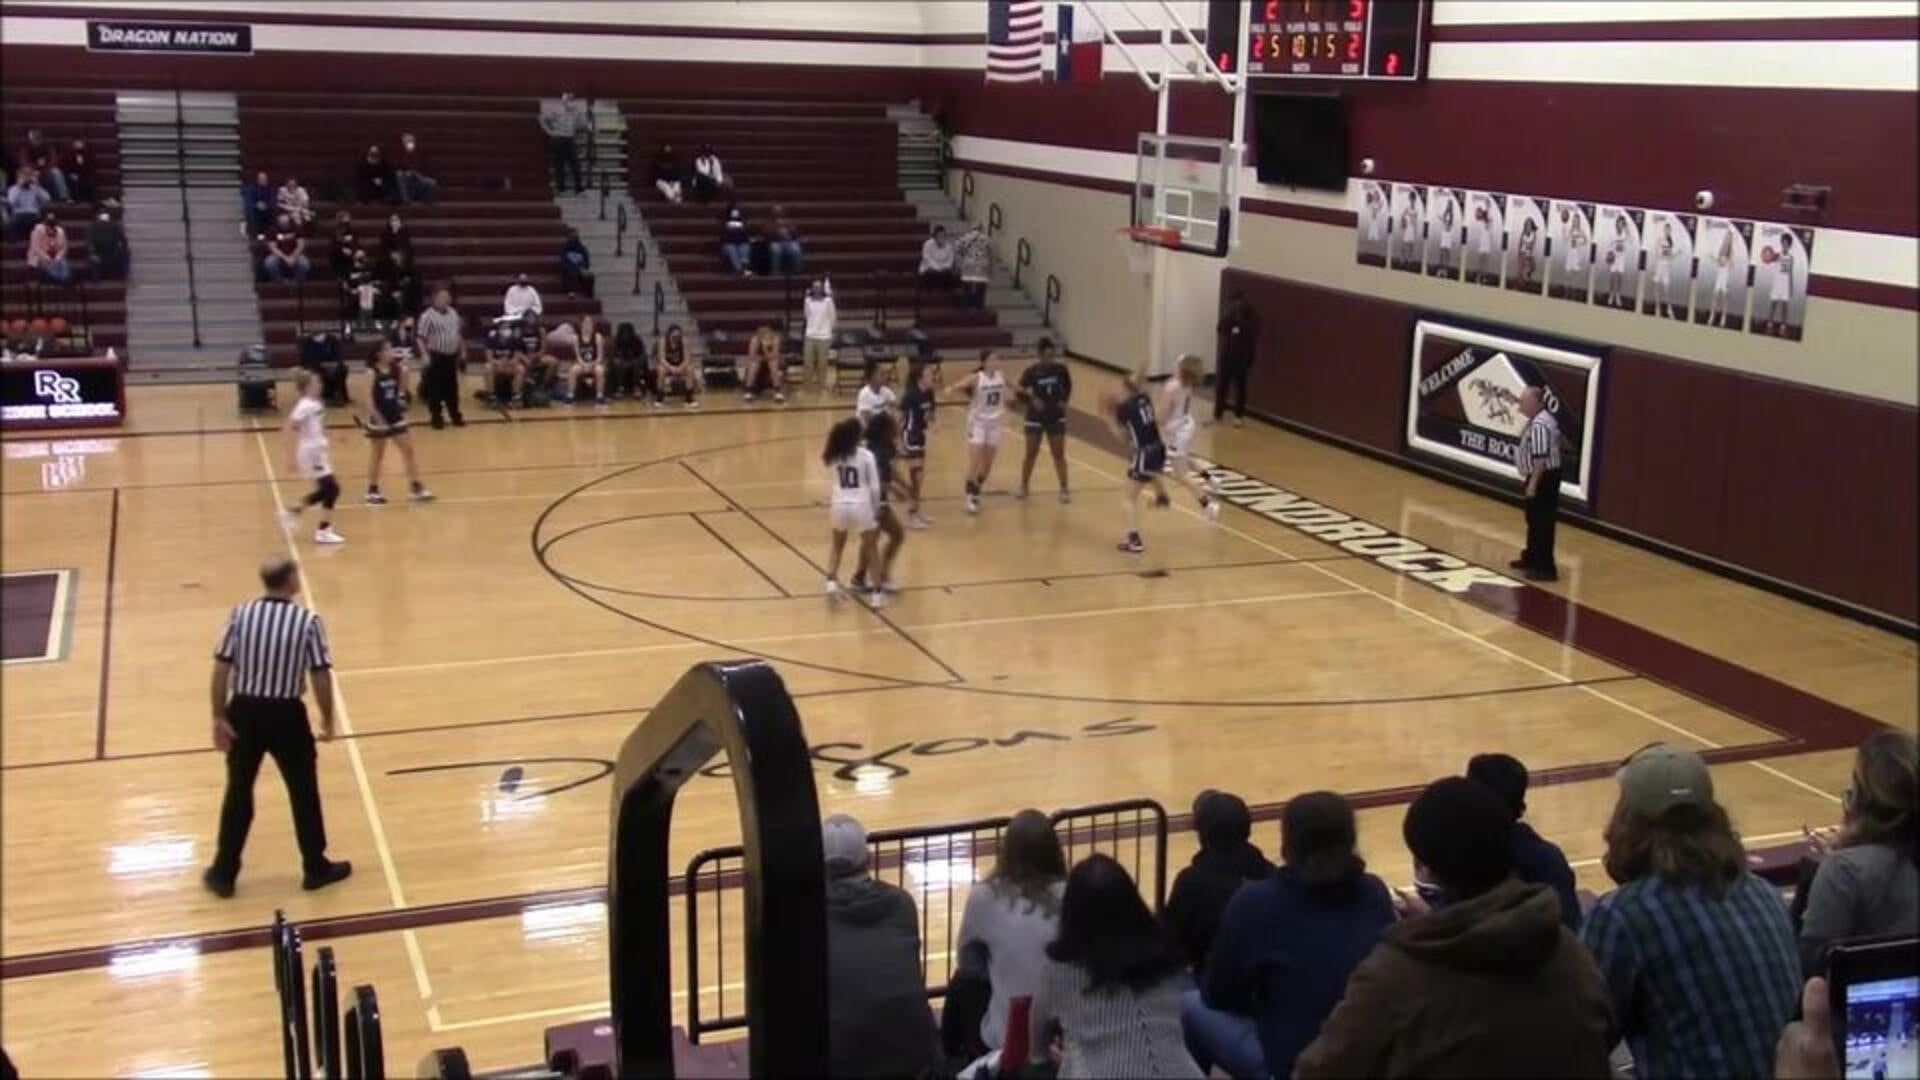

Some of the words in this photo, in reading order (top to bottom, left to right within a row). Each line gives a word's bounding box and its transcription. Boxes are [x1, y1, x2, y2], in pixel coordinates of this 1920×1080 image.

[173, 31, 238, 46] NATION
[1270, 34, 1281, 58] 5
[1326, 33, 1336, 58] 5
[1418, 348, 1476, 397] WELCOME
[1541, 384, 1560, 414] TO
[1460, 429, 1486, 451] THE
[1488, 437, 1519, 460] ROC
[836, 465, 859, 490] 10
